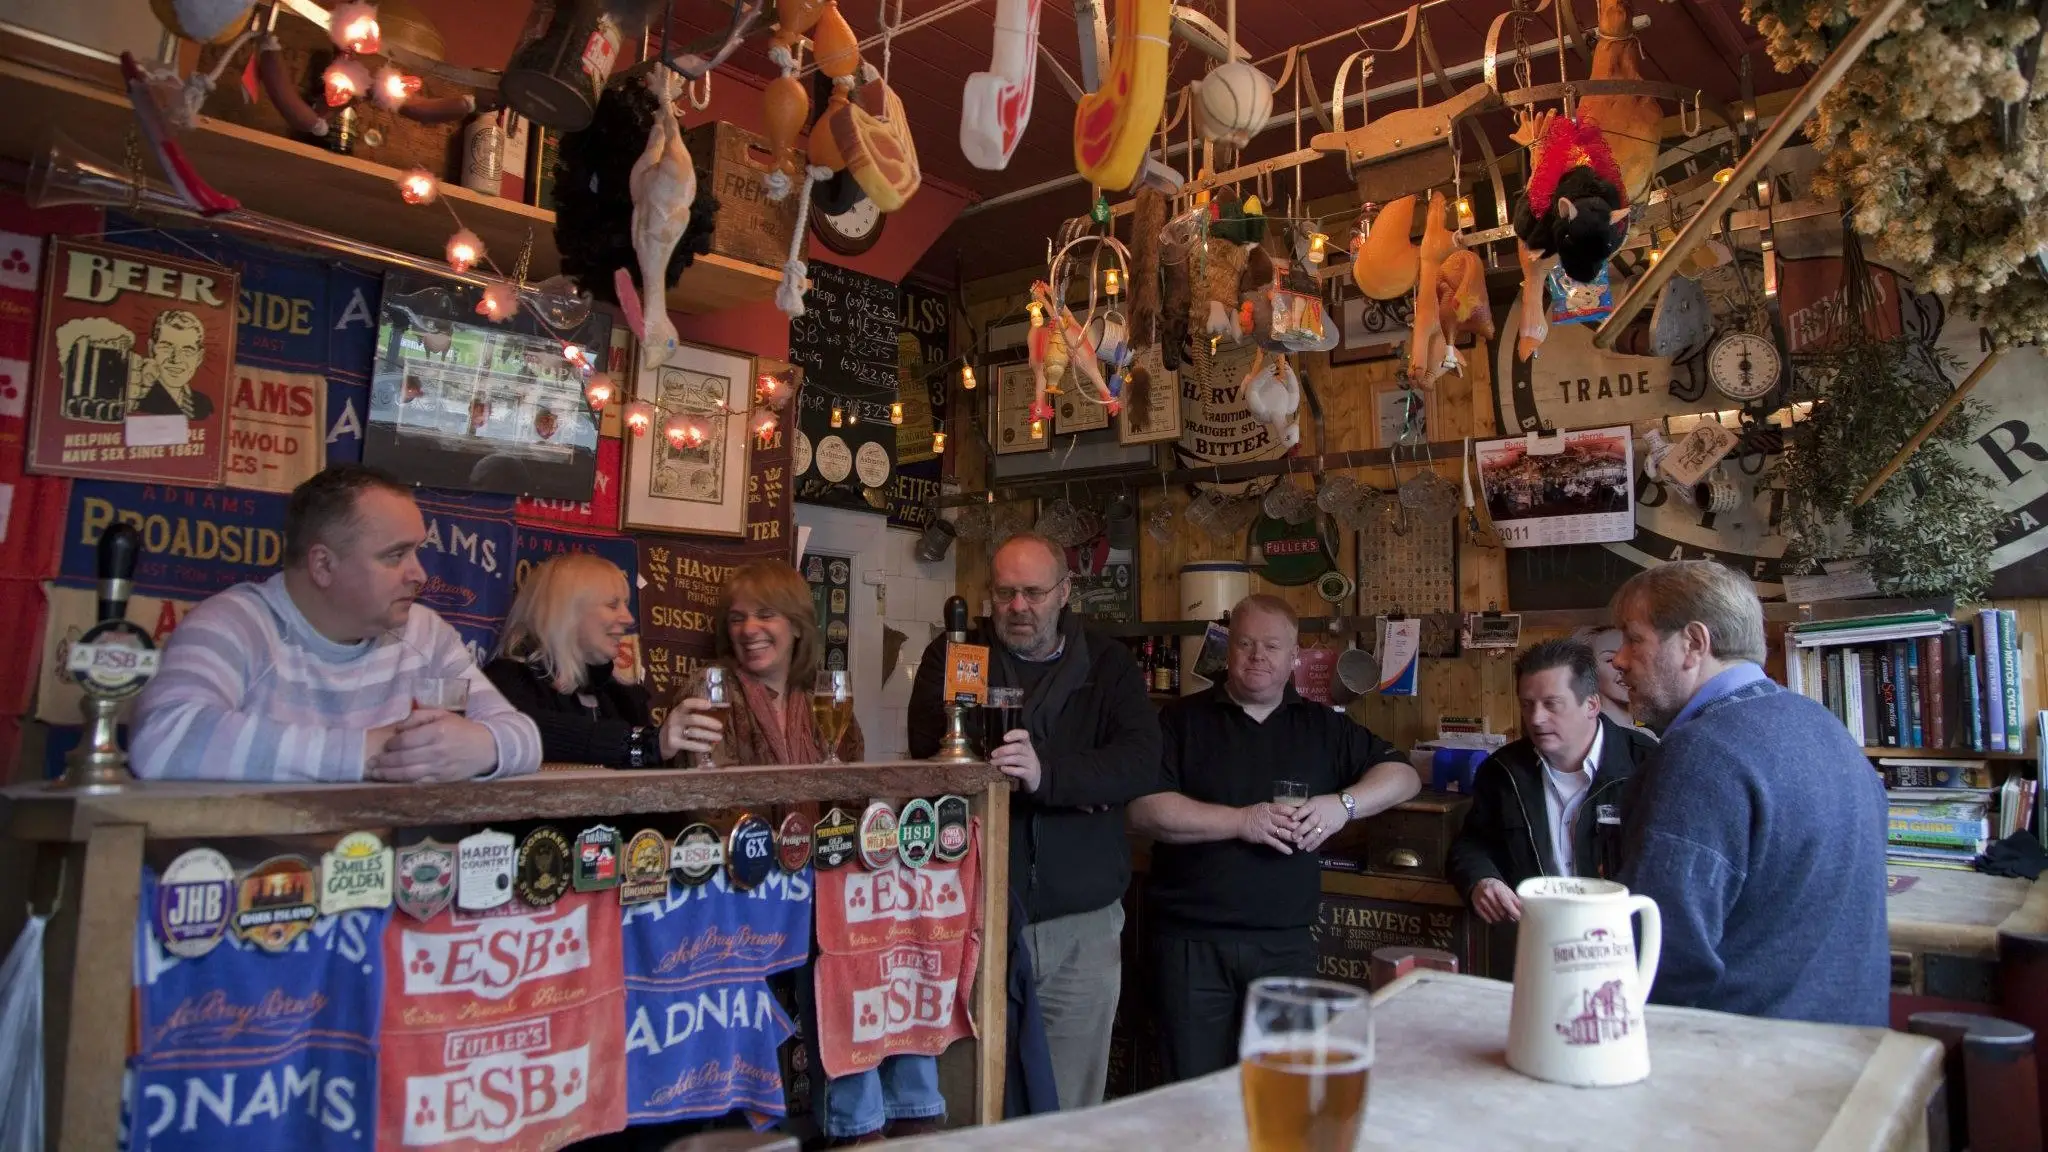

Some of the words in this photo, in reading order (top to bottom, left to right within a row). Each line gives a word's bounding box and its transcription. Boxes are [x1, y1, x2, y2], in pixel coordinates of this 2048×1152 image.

[63, 251, 224, 307] BEER
[237, 288, 315, 336] SIDE
[1559, 370, 1650, 405] TRADE
[63, 432, 121, 447] HELPING
[1195, 431, 1271, 457] BITTER
[62, 448, 98, 463] HAVE
[100, 447, 125, 462] SEX
[129, 446, 165, 460] SINCE
[143, 485, 256, 515] ADNAMS
[81, 497, 284, 567] BROADSID
[1499, 526, 1530, 542] 2011
[1265, 540, 1318, 553] FULLER'S
[651, 605, 715, 634] SUSSEX
[2003, 650, 2016, 686] MOTOR
[1880, 682, 1895, 702] Sex
[2006, 687, 2019, 727] CYCLING
[903, 825, 931, 841] HSB
[461, 844, 510, 859] HARDY
[684, 849, 711, 863] ESB
[745, 837, 769, 859] 6X
[333, 853, 383, 875] SMILES
[461, 856, 510, 870] COUNTRY
[327, 872, 385, 894] GOLDEN
[624, 885, 665, 898] BROADSIDE
[870, 867, 935, 915] ESB
[168, 883, 223, 928] JHB
[1331, 906, 1422, 934] HARVEYS
[1349, 928, 1383, 942] SUSSEX
[440, 924, 556, 989] ESB
[450, 1026, 546, 1060] FULLER'S
[144, 1064, 363, 1140] DNAMS.
[443, 1063, 556, 1132] ESB
